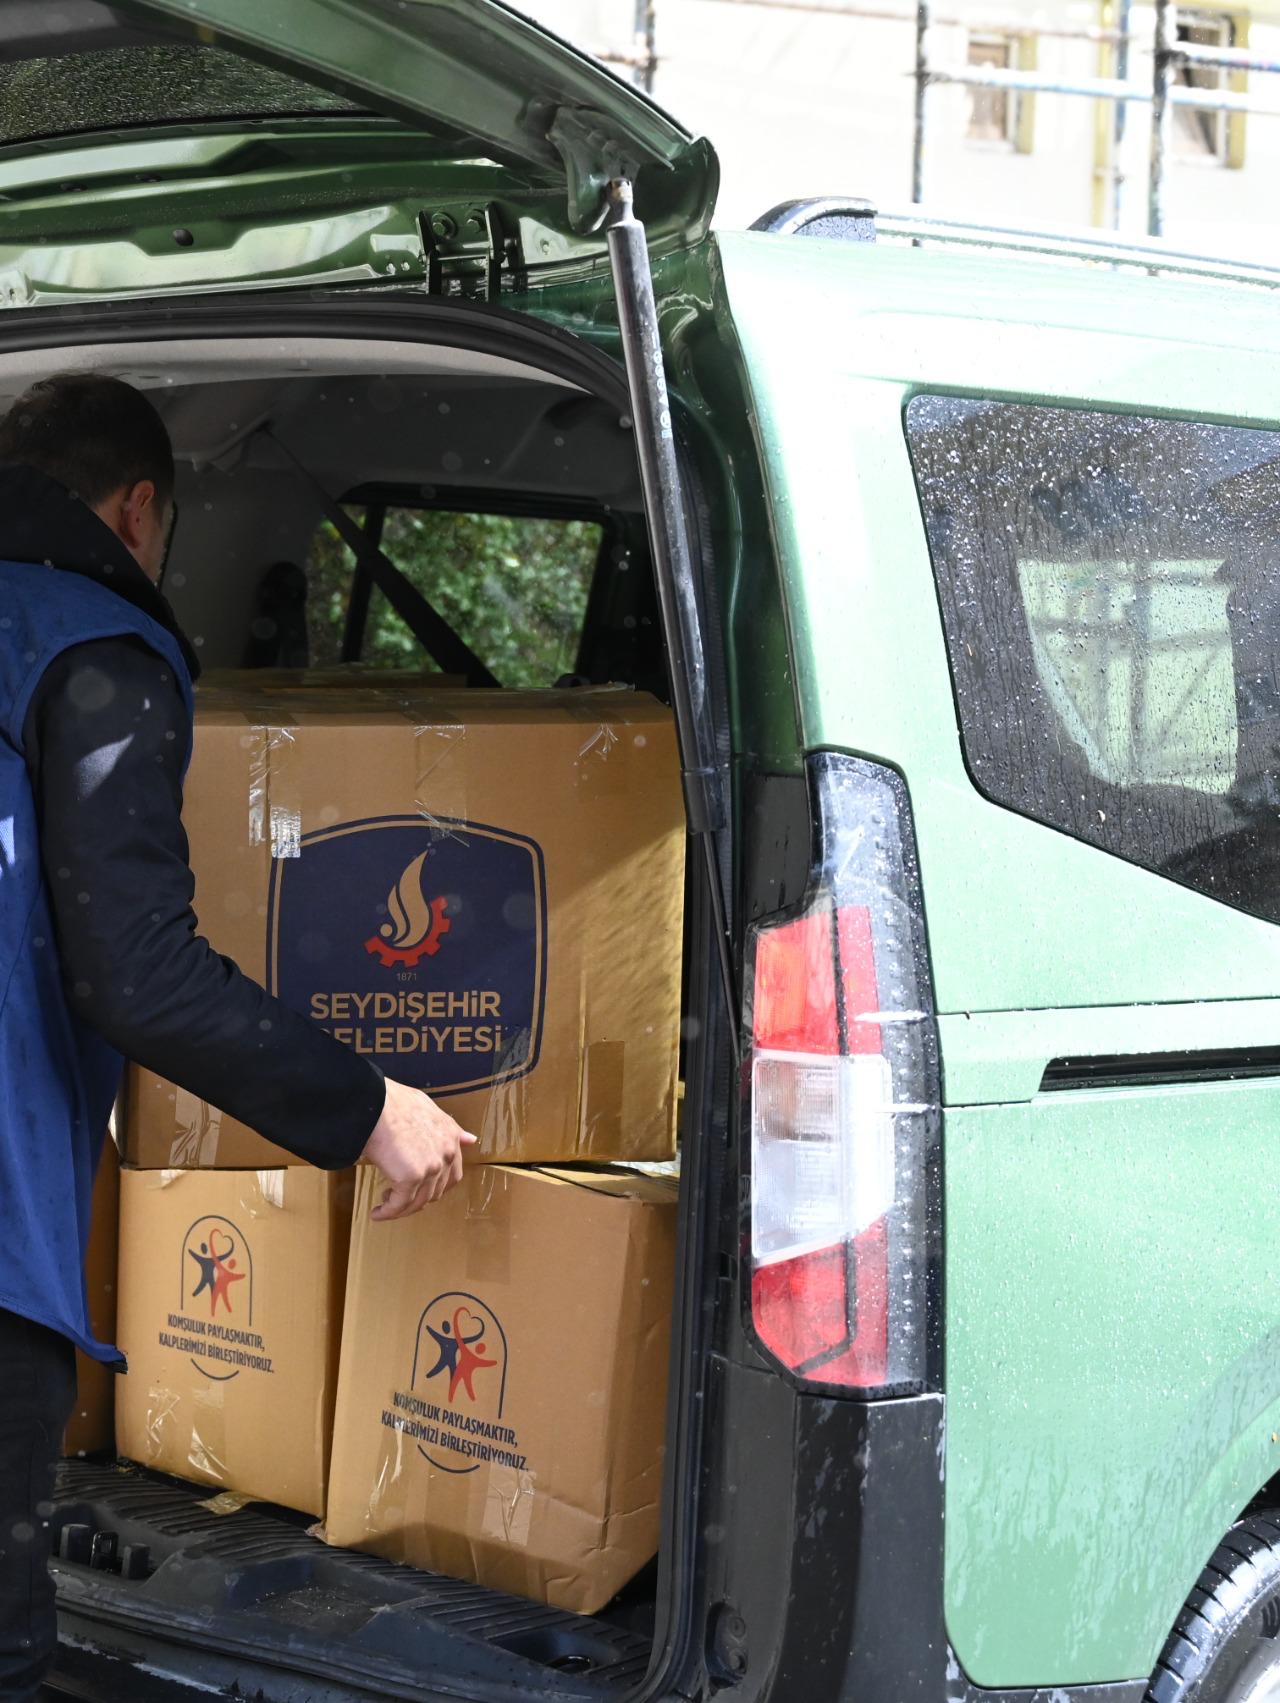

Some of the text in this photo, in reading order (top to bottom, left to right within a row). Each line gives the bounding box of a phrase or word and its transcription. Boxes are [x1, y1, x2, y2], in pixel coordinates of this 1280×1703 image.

[397, 972, 417, 981] 1871
[310, 990, 501, 1024] SEYDİŞEHİR
[321, 1025, 502, 1053] ELEDİYESİ
[167, 1313, 265, 1352] KOMŞULUK PAYLAŞMAKTIR,
[159, 1331, 275, 1374] KALPLERİMİZİ BİRLEŞTİRİYORUZ.
[393, 1391, 518, 1447] KOMŞULUK PAYLAŞMAKTIR,
[439, 1431, 530, 1472] BİRLEŞTİRİYORUZ.
